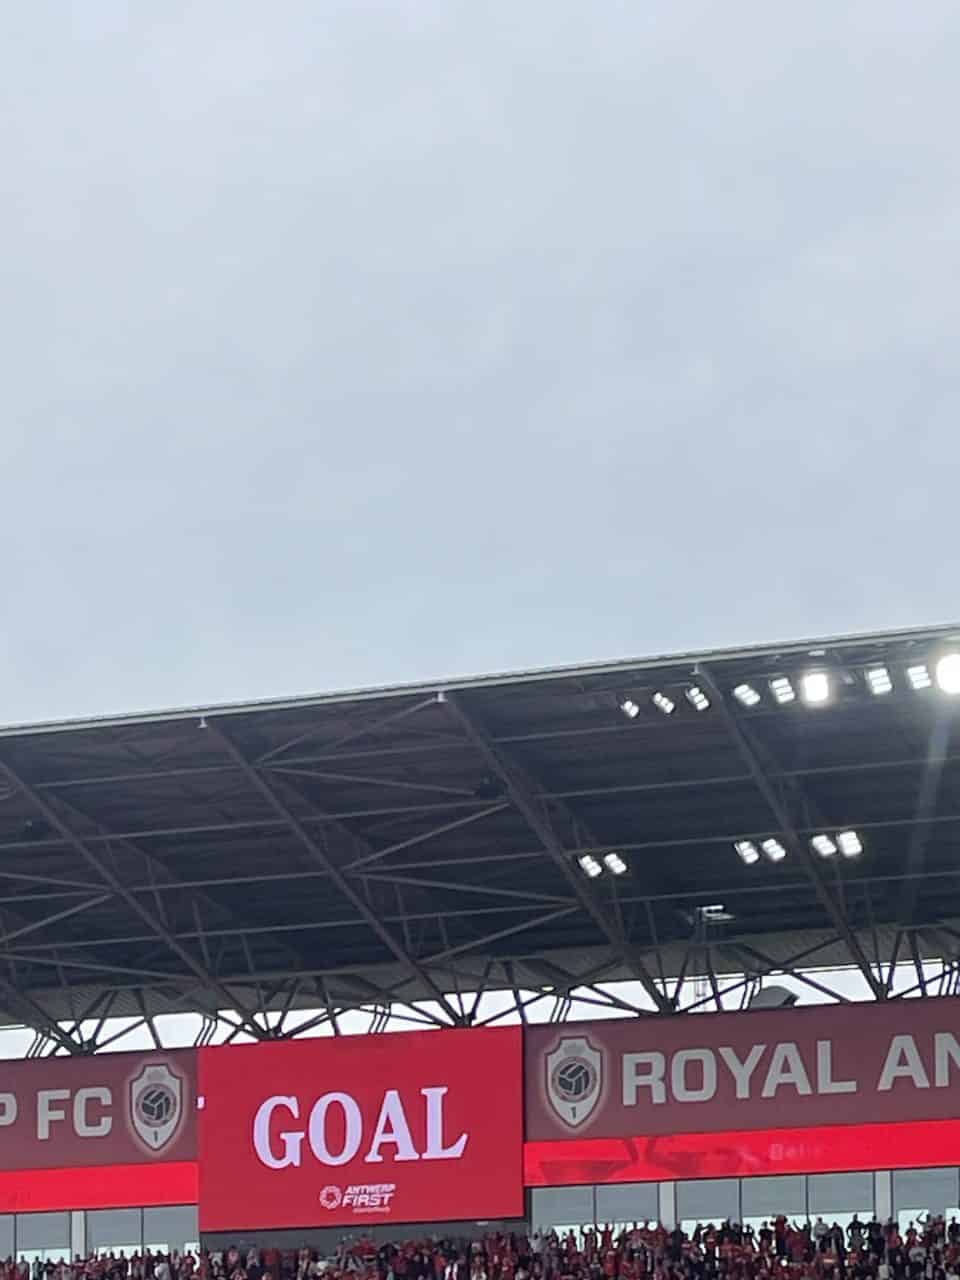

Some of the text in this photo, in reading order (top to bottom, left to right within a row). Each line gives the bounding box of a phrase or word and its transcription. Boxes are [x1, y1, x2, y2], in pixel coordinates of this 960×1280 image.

[622, 1039, 857, 1106] ROYAL
[37, 1087, 112, 1140] FC
[253, 1086, 469, 1169] GOAL
[342, 1193, 394, 1207] FIRST
